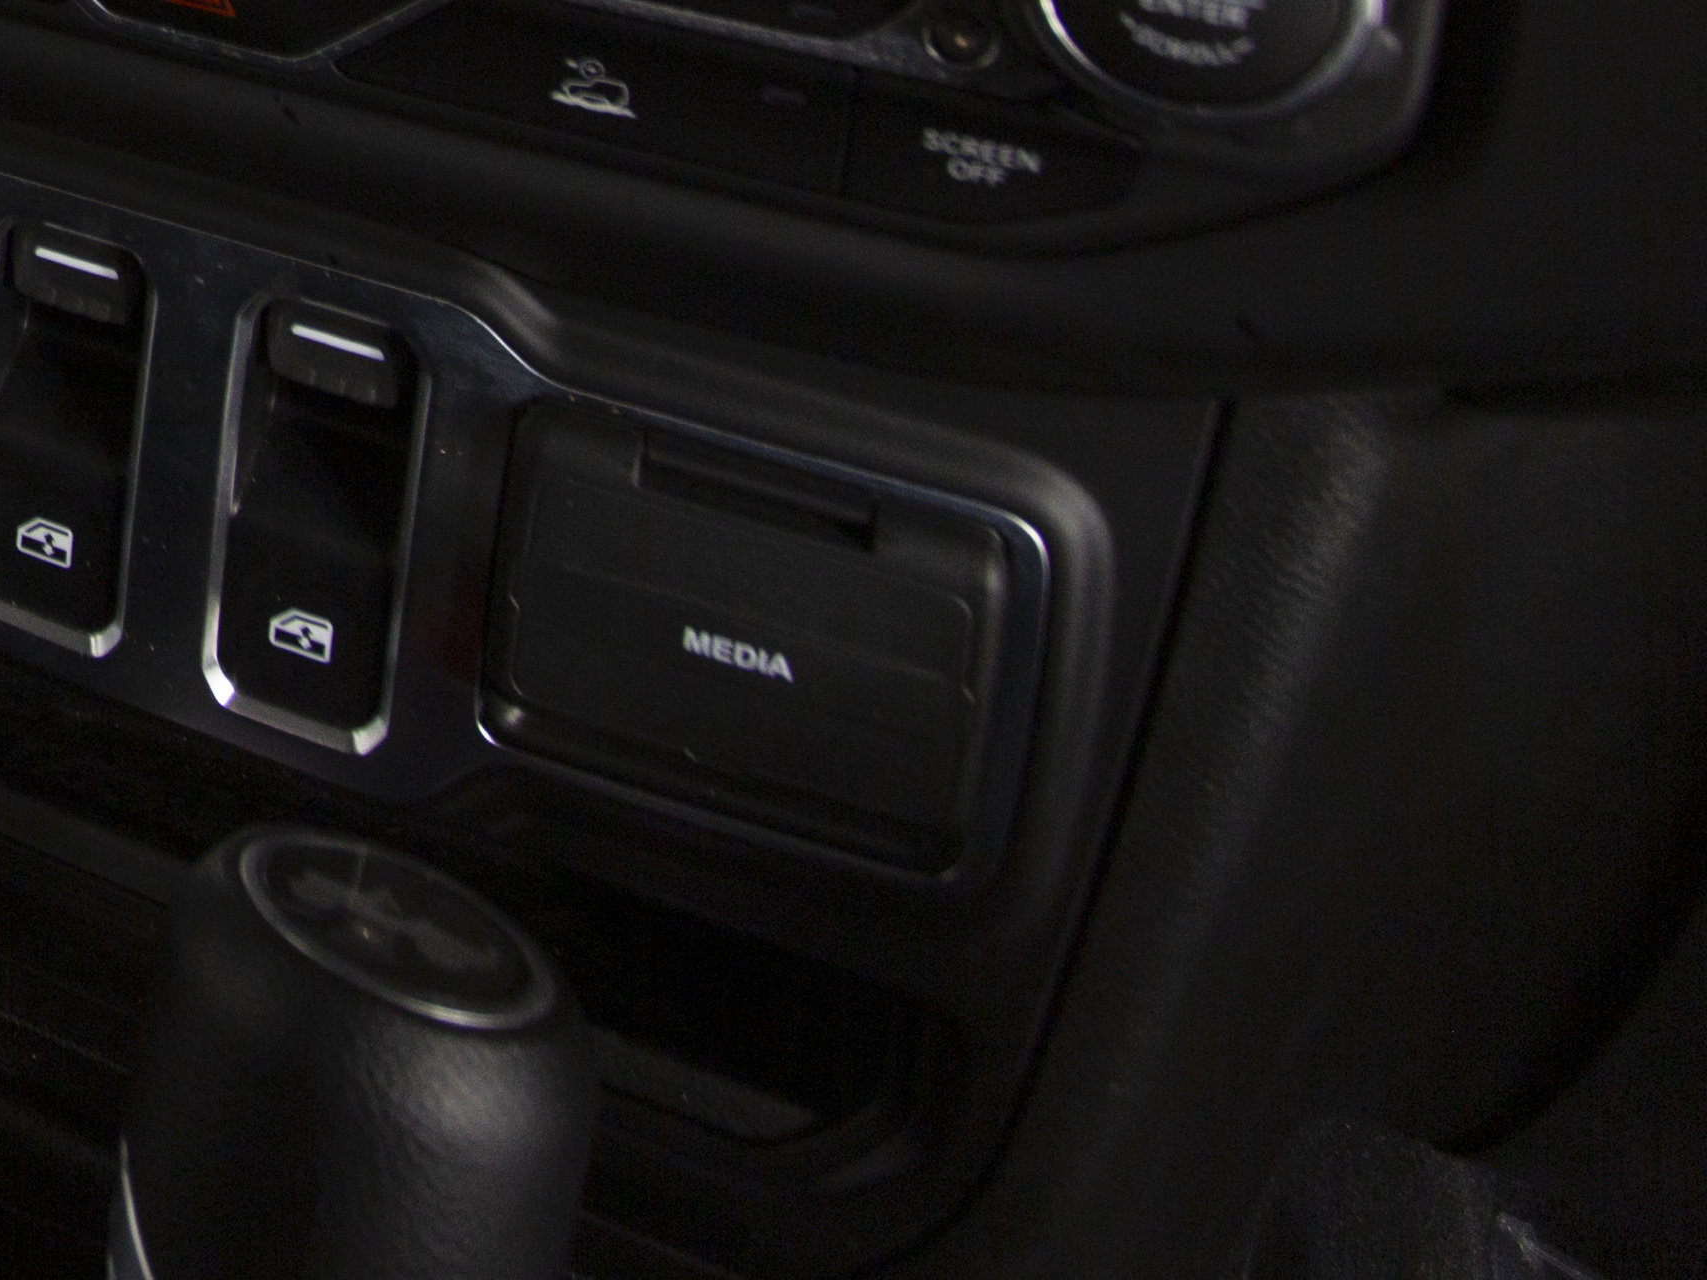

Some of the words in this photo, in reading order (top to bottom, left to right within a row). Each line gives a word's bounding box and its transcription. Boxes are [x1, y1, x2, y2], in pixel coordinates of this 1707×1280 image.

[923, 127, 1043, 176] SCREEN
[947, 155, 1008, 186] OFF
[682, 624, 795, 684] MEDIA
